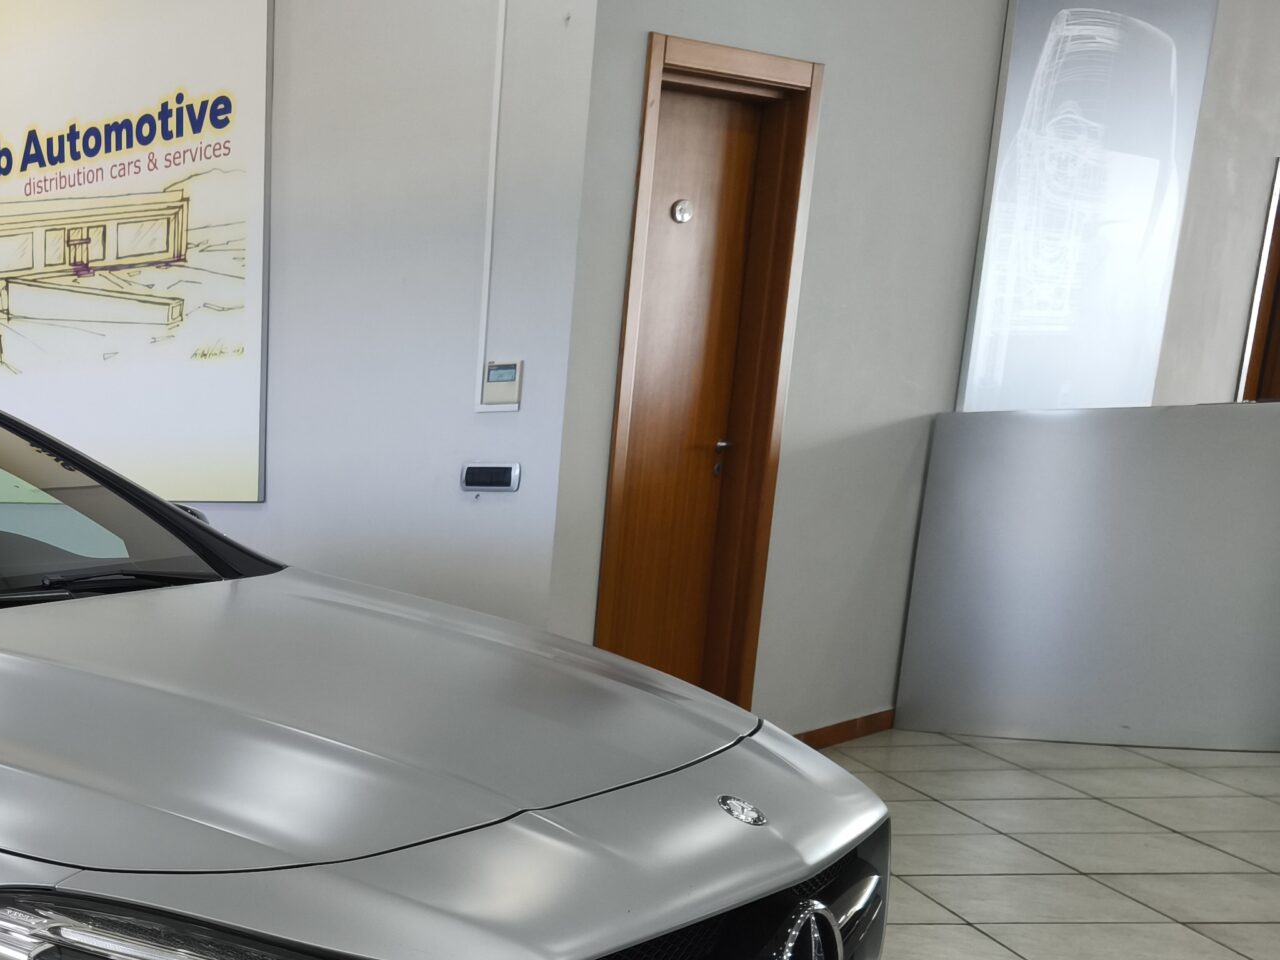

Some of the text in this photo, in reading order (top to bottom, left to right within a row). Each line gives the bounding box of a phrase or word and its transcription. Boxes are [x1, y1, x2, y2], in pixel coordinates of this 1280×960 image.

[20, 92, 232, 172] Automotive
[24, 139, 231, 197] distribution cars & services
